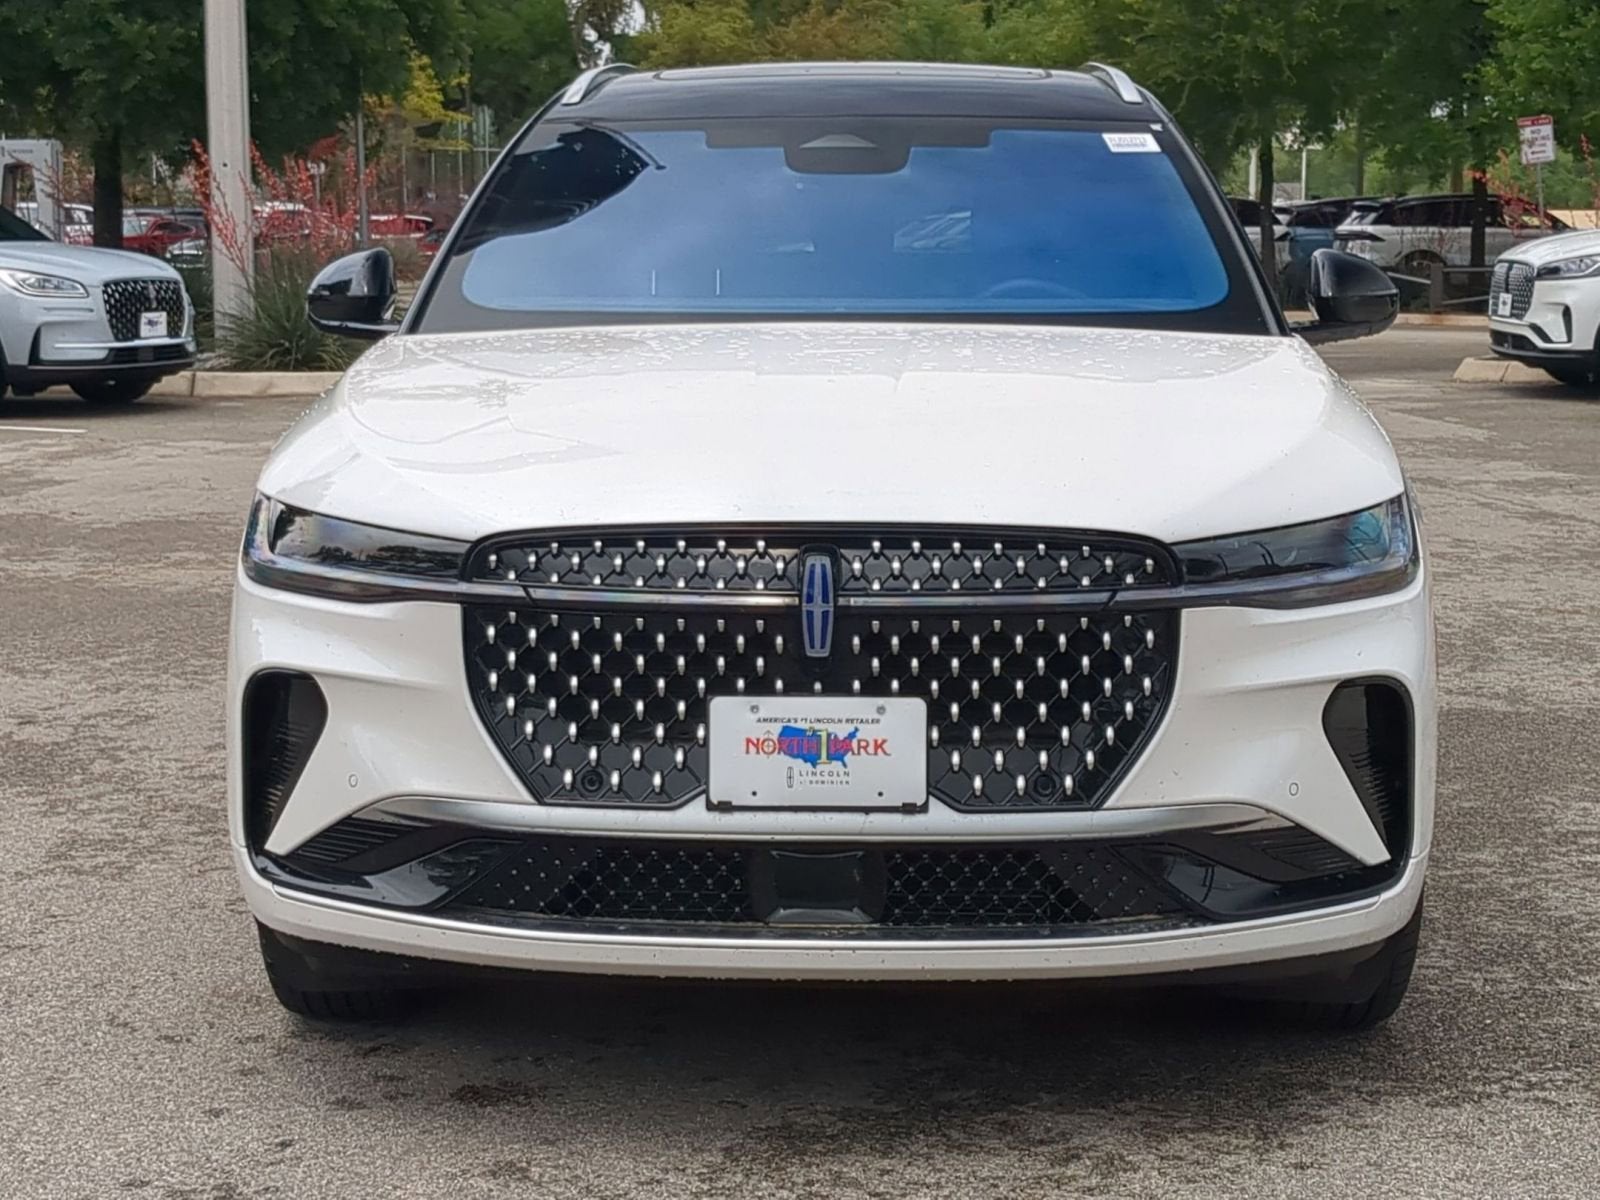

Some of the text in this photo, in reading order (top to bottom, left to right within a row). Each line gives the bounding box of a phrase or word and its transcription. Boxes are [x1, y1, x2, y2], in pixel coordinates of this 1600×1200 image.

[809, 717, 843, 725] LINCOLN
[745, 737, 892, 757] NORTH PARK
